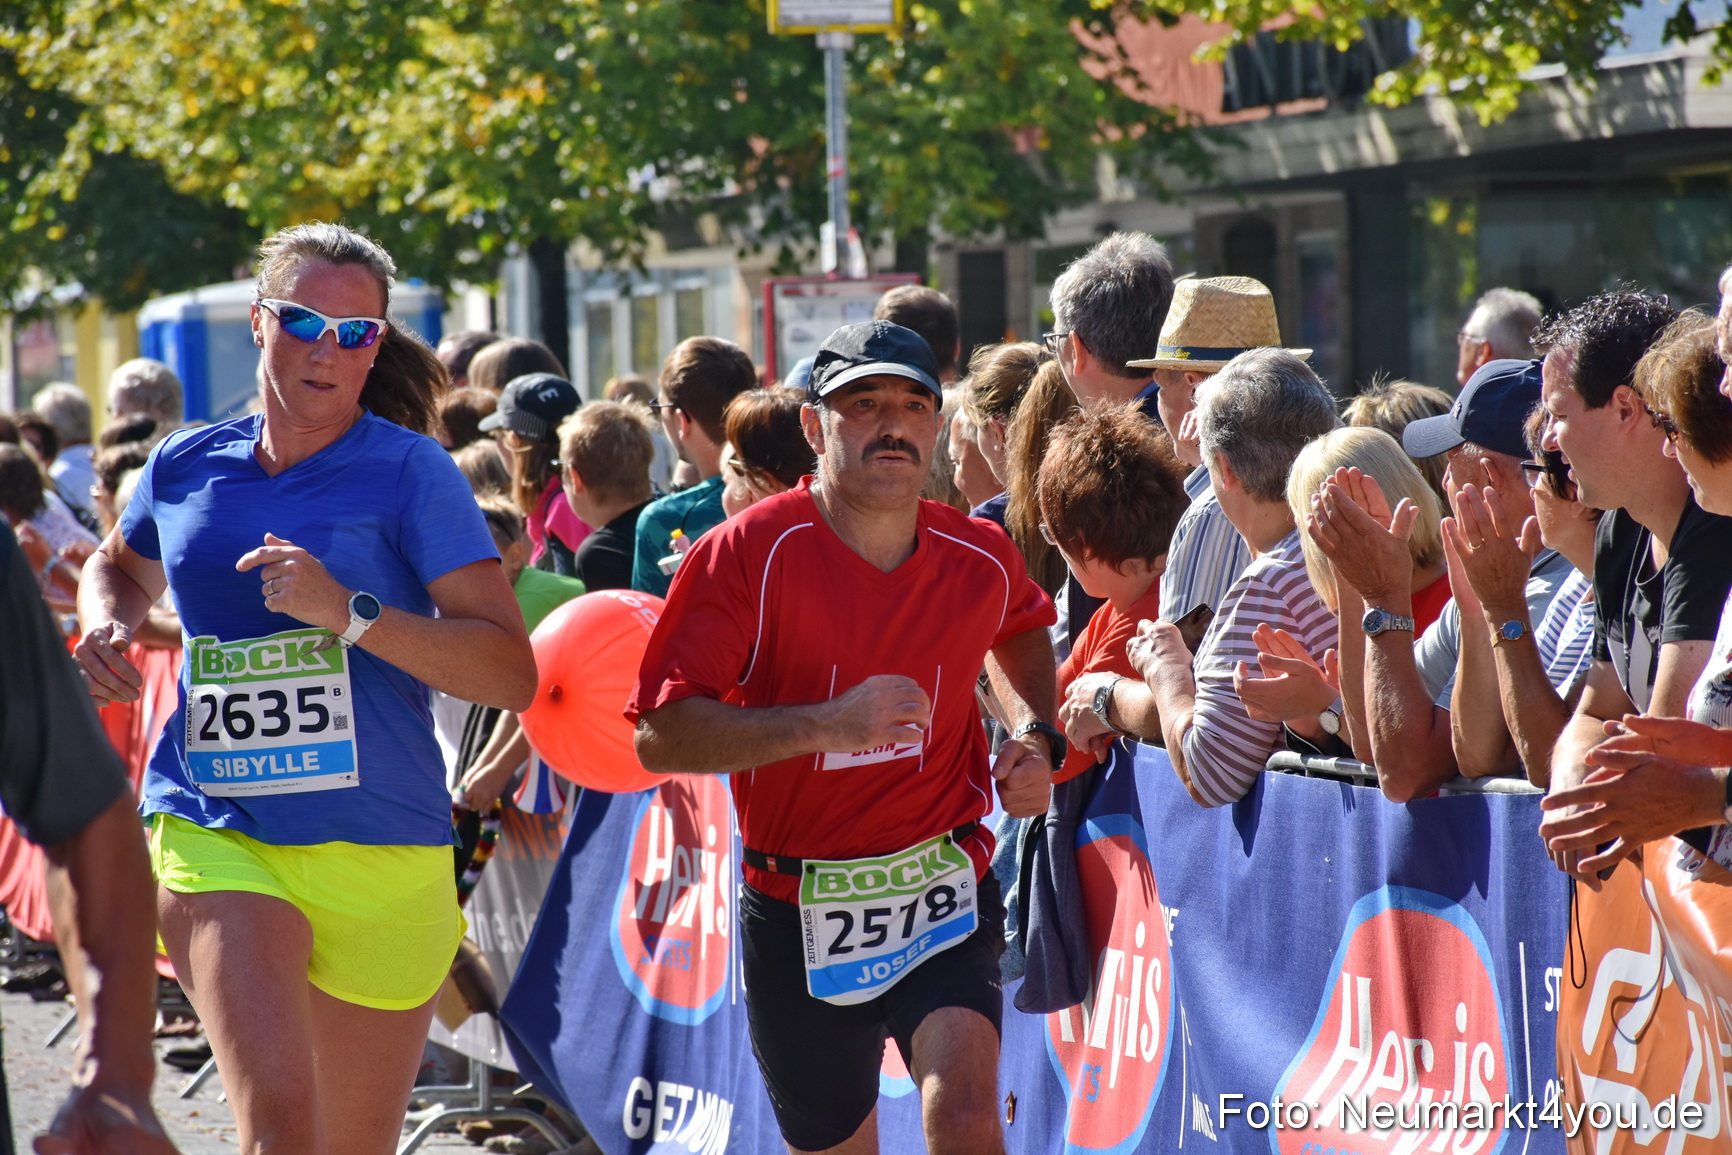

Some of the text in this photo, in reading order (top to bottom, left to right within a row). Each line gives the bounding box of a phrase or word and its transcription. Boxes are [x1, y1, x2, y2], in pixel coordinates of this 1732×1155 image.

[200, 686, 330, 742] 2635
[333, 688, 342, 697] B
[212, 751, 320, 778] SIBYLLE
[814, 843, 960, 899] BOCK
[961, 881, 969, 889] C
[825, 884, 958, 956] 2578
[641, 935, 691, 971] SRTS
[856, 934, 932, 984] JOSEF
[1058, 921, 1162, 1089] rvis
[623, 1076, 694, 1143] GET
